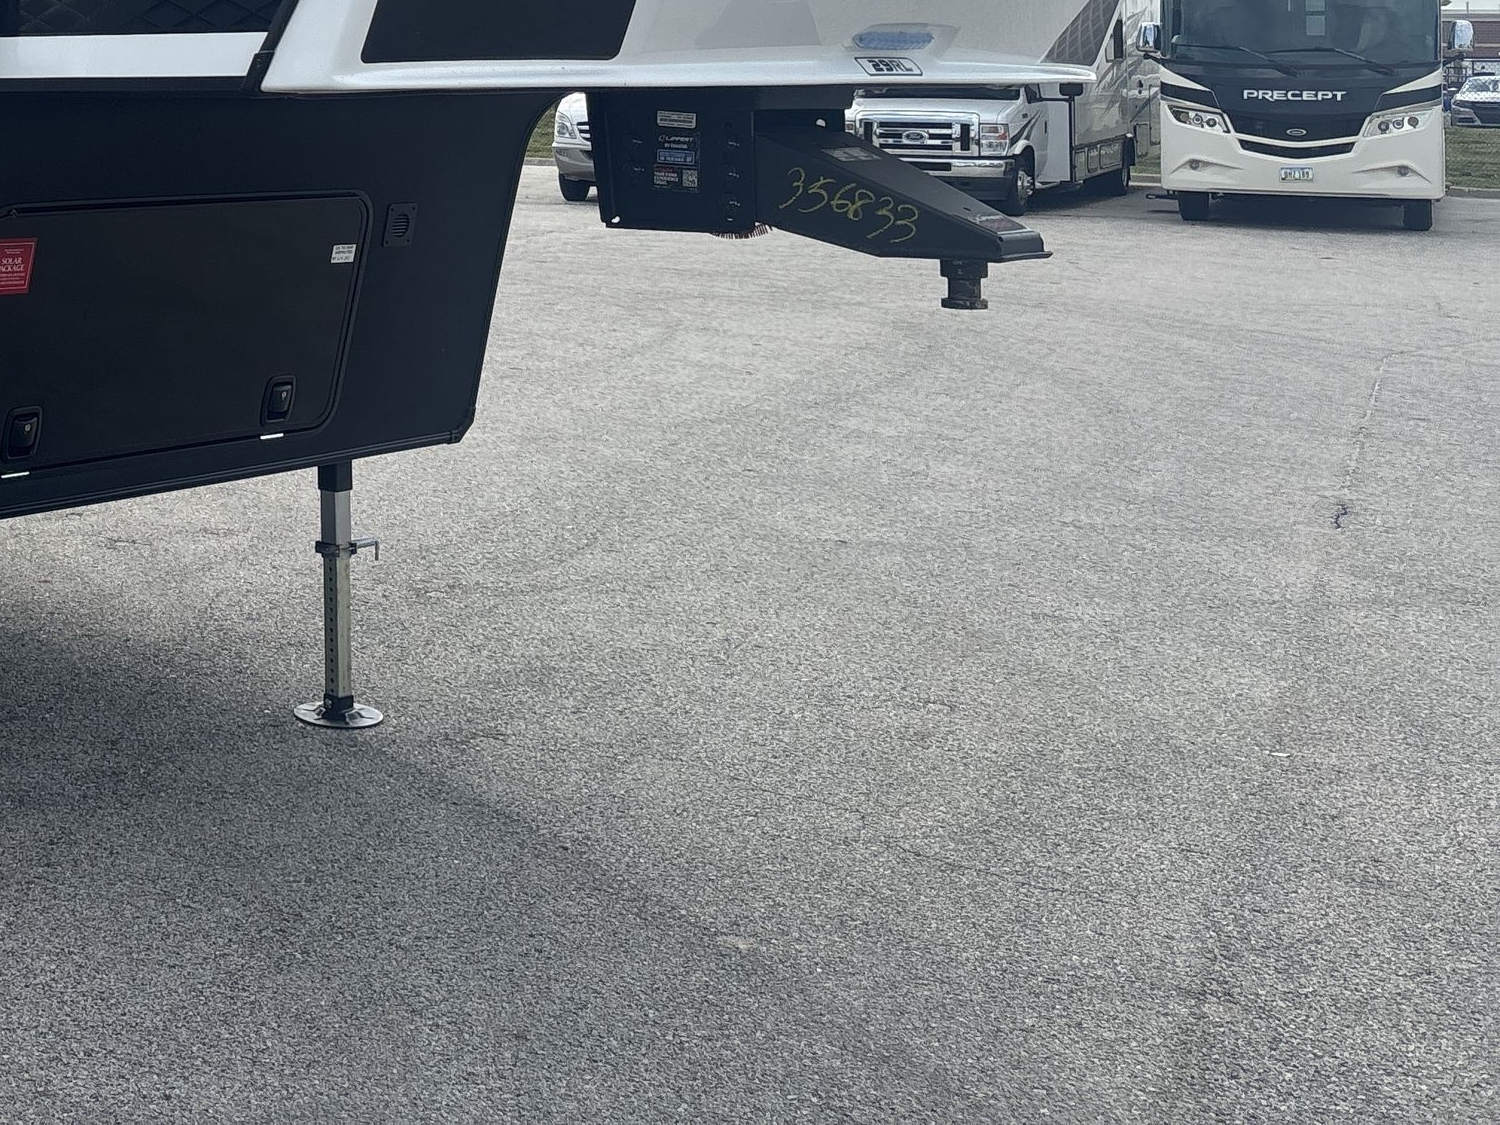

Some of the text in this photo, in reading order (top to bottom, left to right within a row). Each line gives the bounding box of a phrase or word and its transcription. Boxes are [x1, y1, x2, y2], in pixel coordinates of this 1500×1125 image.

[866, 59, 914, 72] 29RL
[1243, 89, 1348, 102] PRECEPT
[779, 166, 920, 244] 356833
[1, 257, 23, 265] SOLAR
